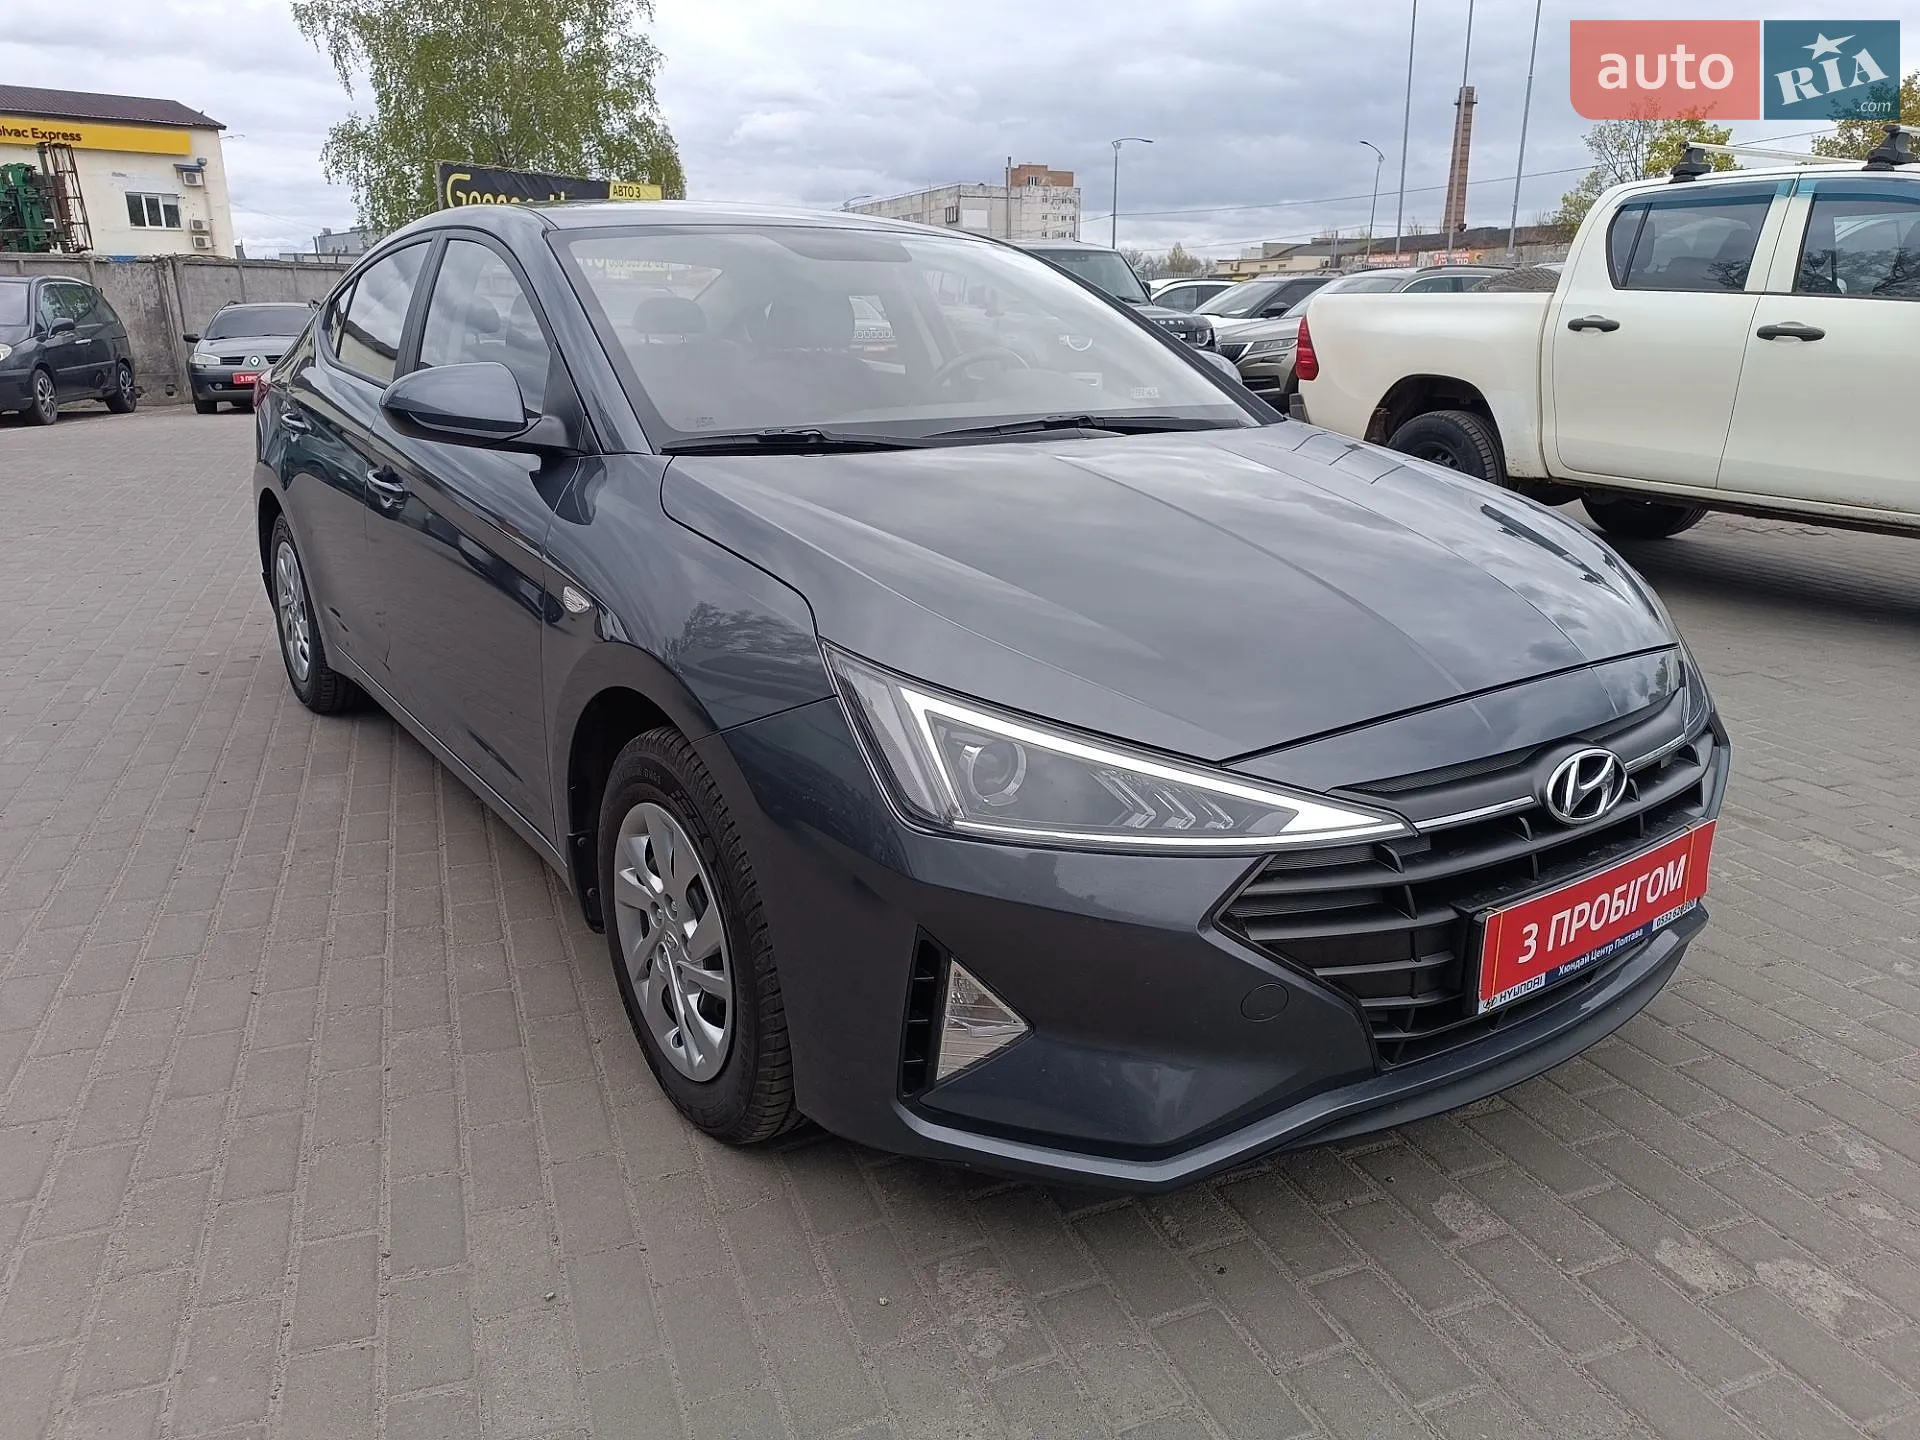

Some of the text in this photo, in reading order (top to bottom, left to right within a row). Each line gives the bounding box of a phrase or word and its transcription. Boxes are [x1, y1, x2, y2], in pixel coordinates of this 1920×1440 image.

[0, 126, 82, 141] lvac Express
[1547, 853, 1687, 952] ПРОБІГОМ
[1558, 928, 1644, 976] Хюндай Центр Полтава
[1500, 976, 1543, 1001] HYUNDAI
